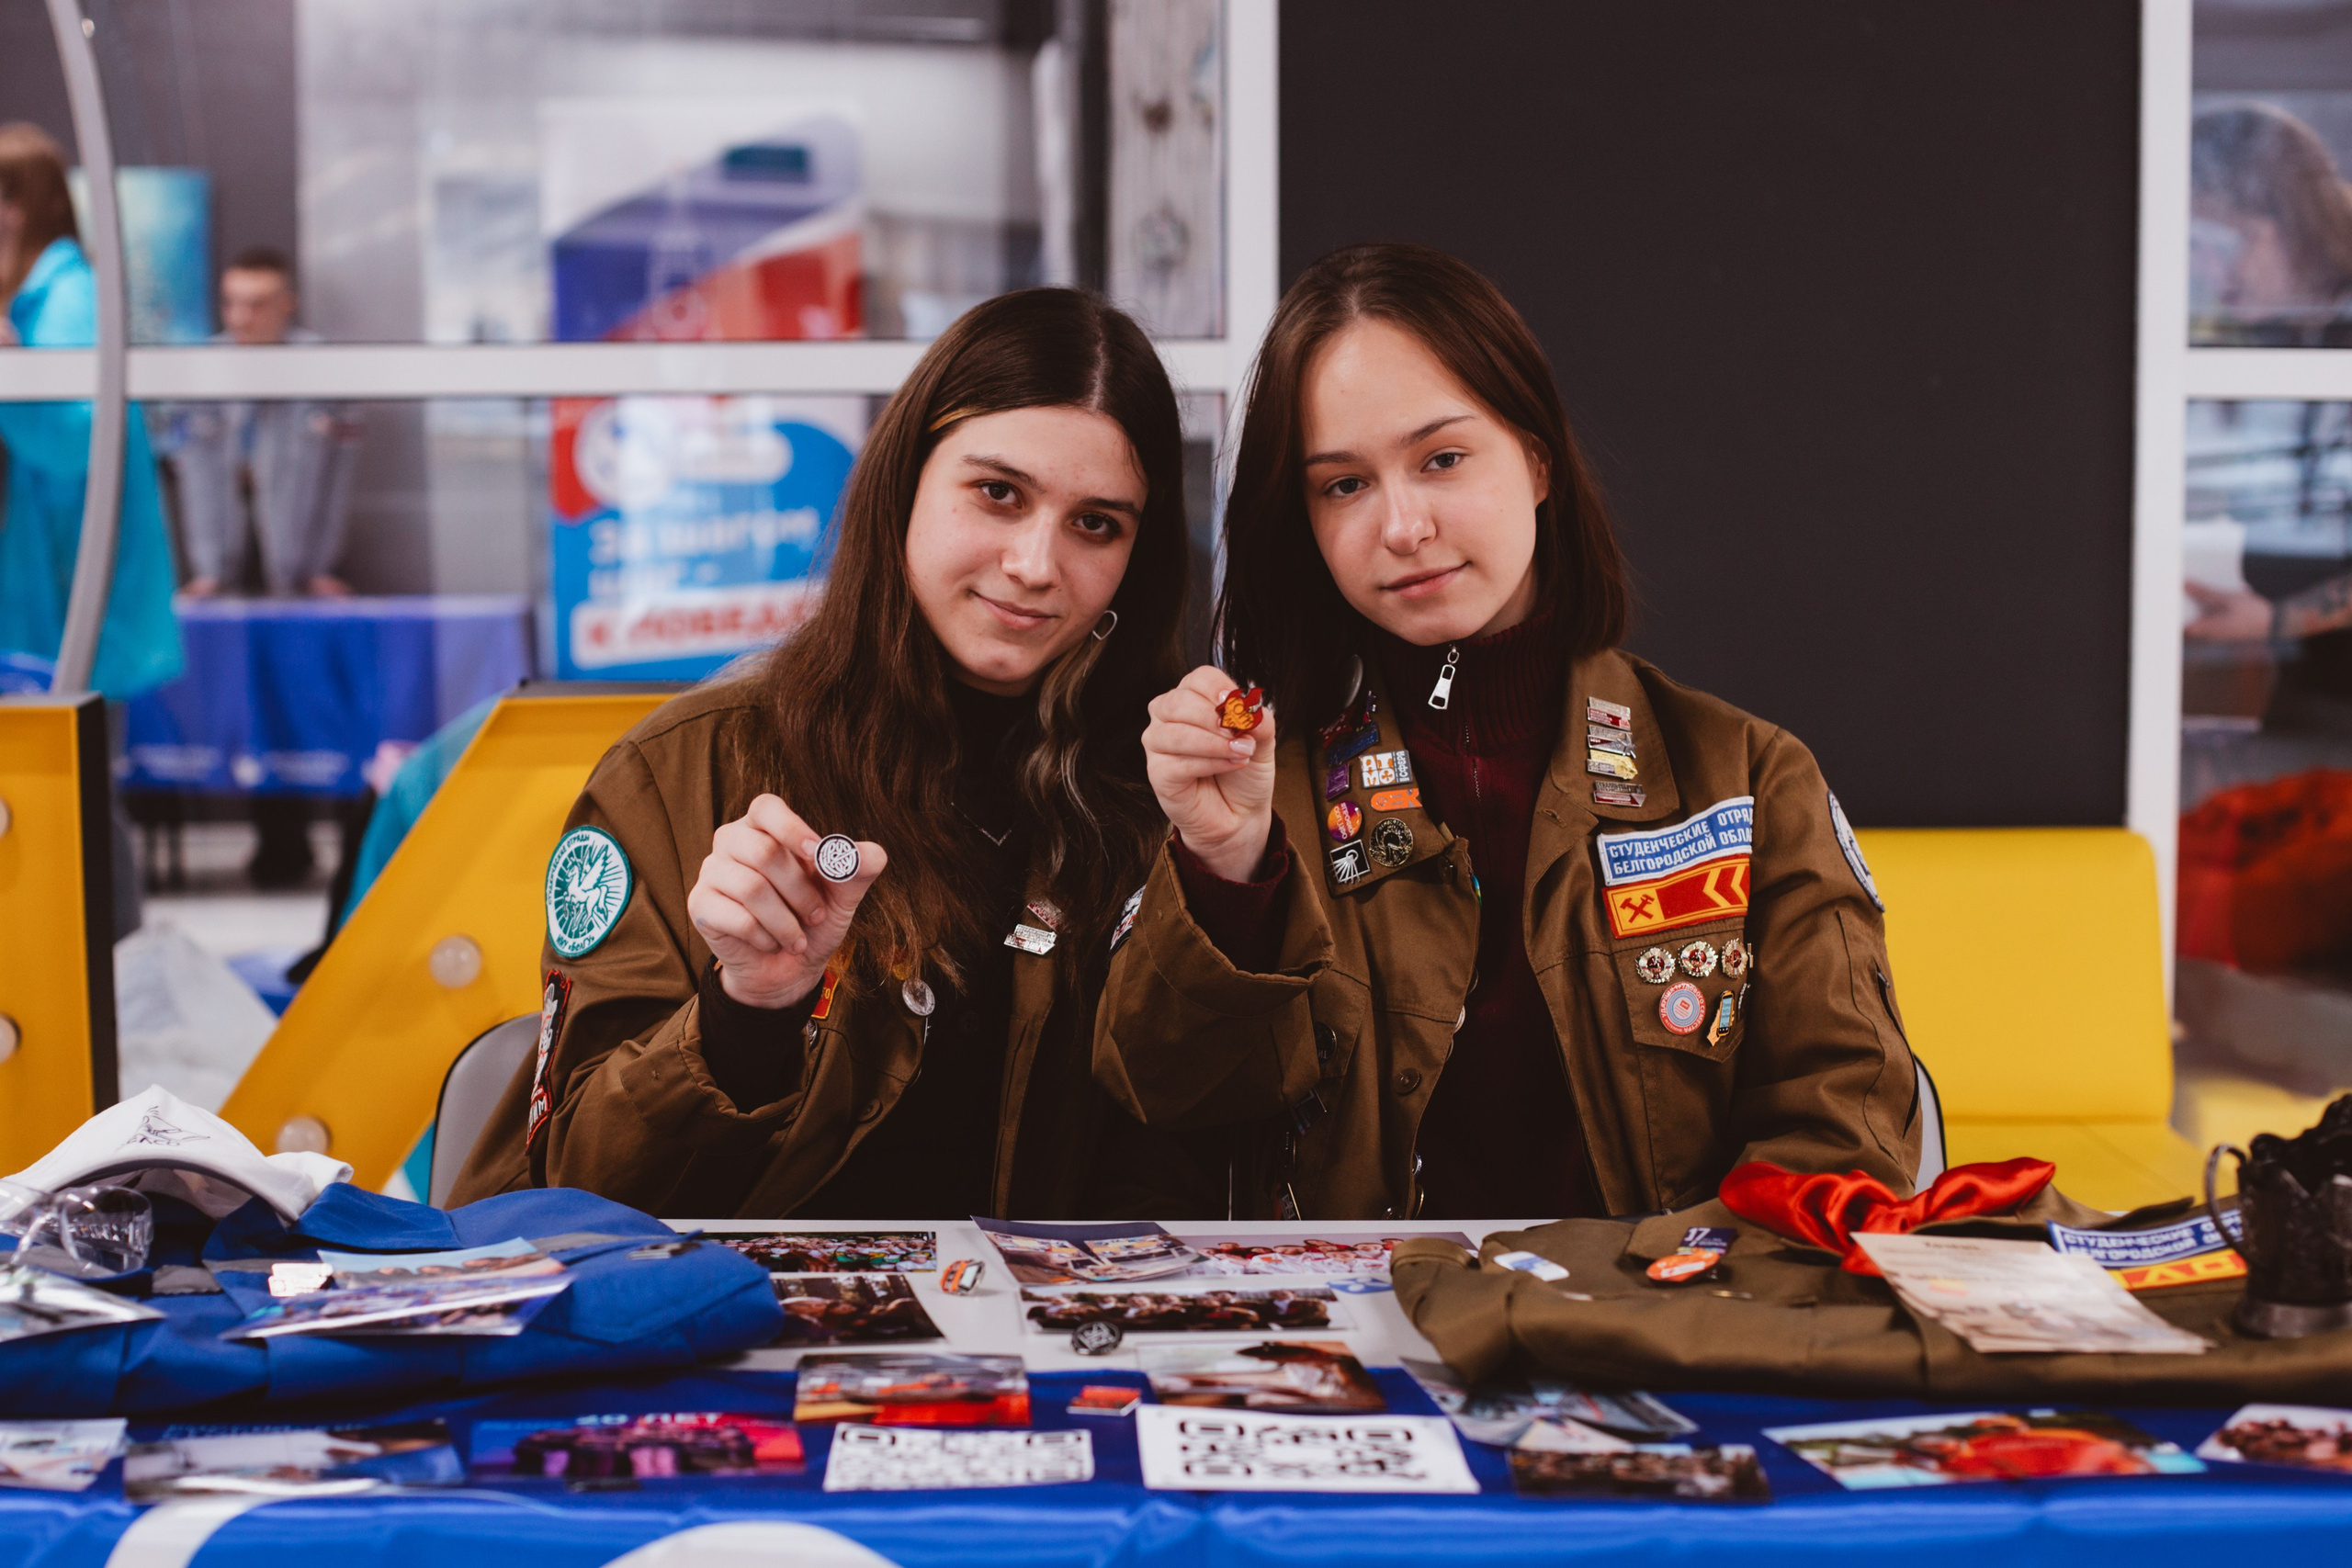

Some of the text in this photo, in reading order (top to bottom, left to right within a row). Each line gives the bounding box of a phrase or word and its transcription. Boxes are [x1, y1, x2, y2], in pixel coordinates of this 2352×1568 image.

[1608, 820, 1711, 858] СТУДЕНЧЕСКИЕ
[1613, 832, 1716, 875] БЕЛГОРОДСКОЙ
[2064, 1226, 2195, 1249] СТУДЕНЧЕСКИЕ
